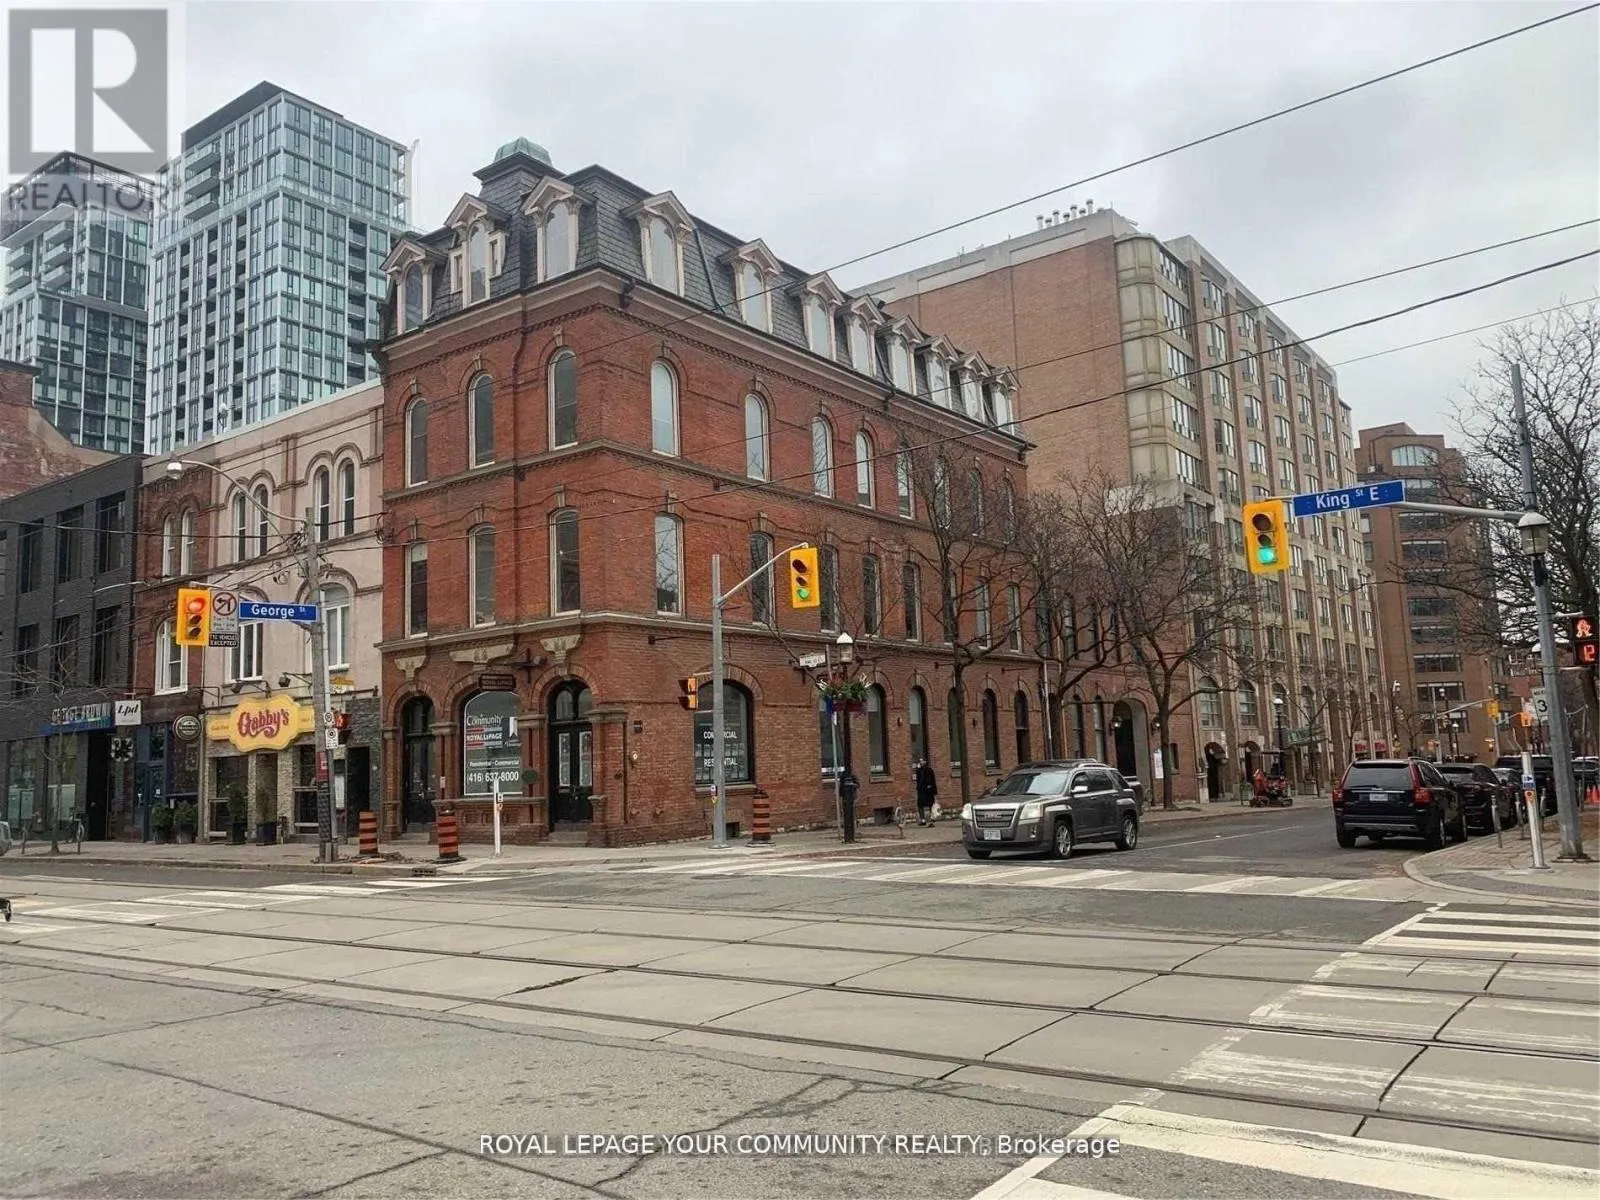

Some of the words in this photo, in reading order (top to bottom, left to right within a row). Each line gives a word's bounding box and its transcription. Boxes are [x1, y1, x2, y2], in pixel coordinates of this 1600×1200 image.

[1316, 493, 1350, 509] King
[1355, 488, 1364, 497] St
[1370, 486, 1379, 501] E
[251, 604, 295, 618] George
[238, 708, 290, 738] Gabby's
[466, 714, 503, 727] Community
[467, 733, 484, 741] ROYAL
[467, 772, 483, 783] (416)
